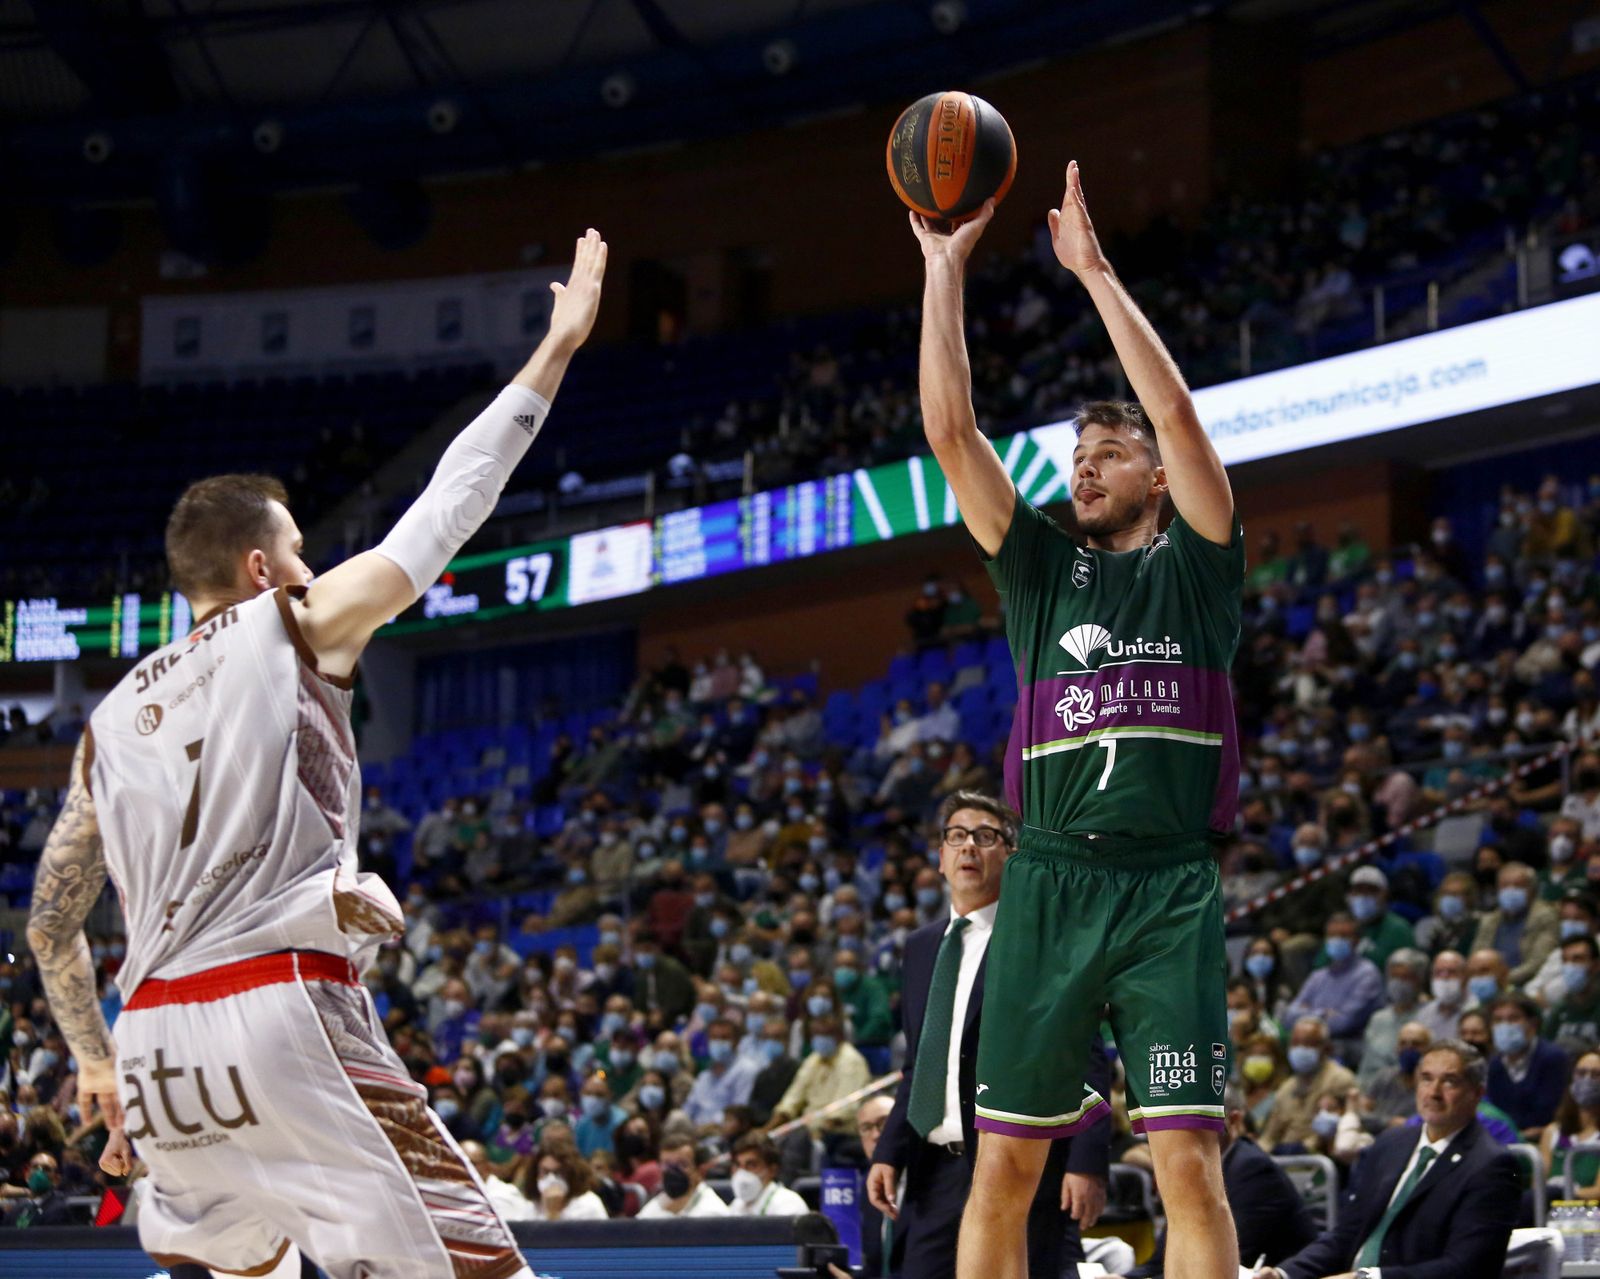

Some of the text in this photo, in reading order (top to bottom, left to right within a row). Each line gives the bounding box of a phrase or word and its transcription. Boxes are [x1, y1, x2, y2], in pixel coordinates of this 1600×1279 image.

[505, 552, 552, 605] 57
[1106, 636, 1182, 659] Unicaja
[1101, 677, 1179, 702] MÁLAGA
[1136, 704, 1142, 715] y
[1151, 702, 1181, 714] Eventos
[1097, 739, 1117, 791] 7
[180, 736, 205, 851] 7
[1149, 1043, 1171, 1052] sabor
[1156, 1044, 1198, 1068] má
[1149, 1063, 1198, 1090] laga
[124, 1048, 260, 1140] atu
[824, 1187, 854, 1205] IRS
